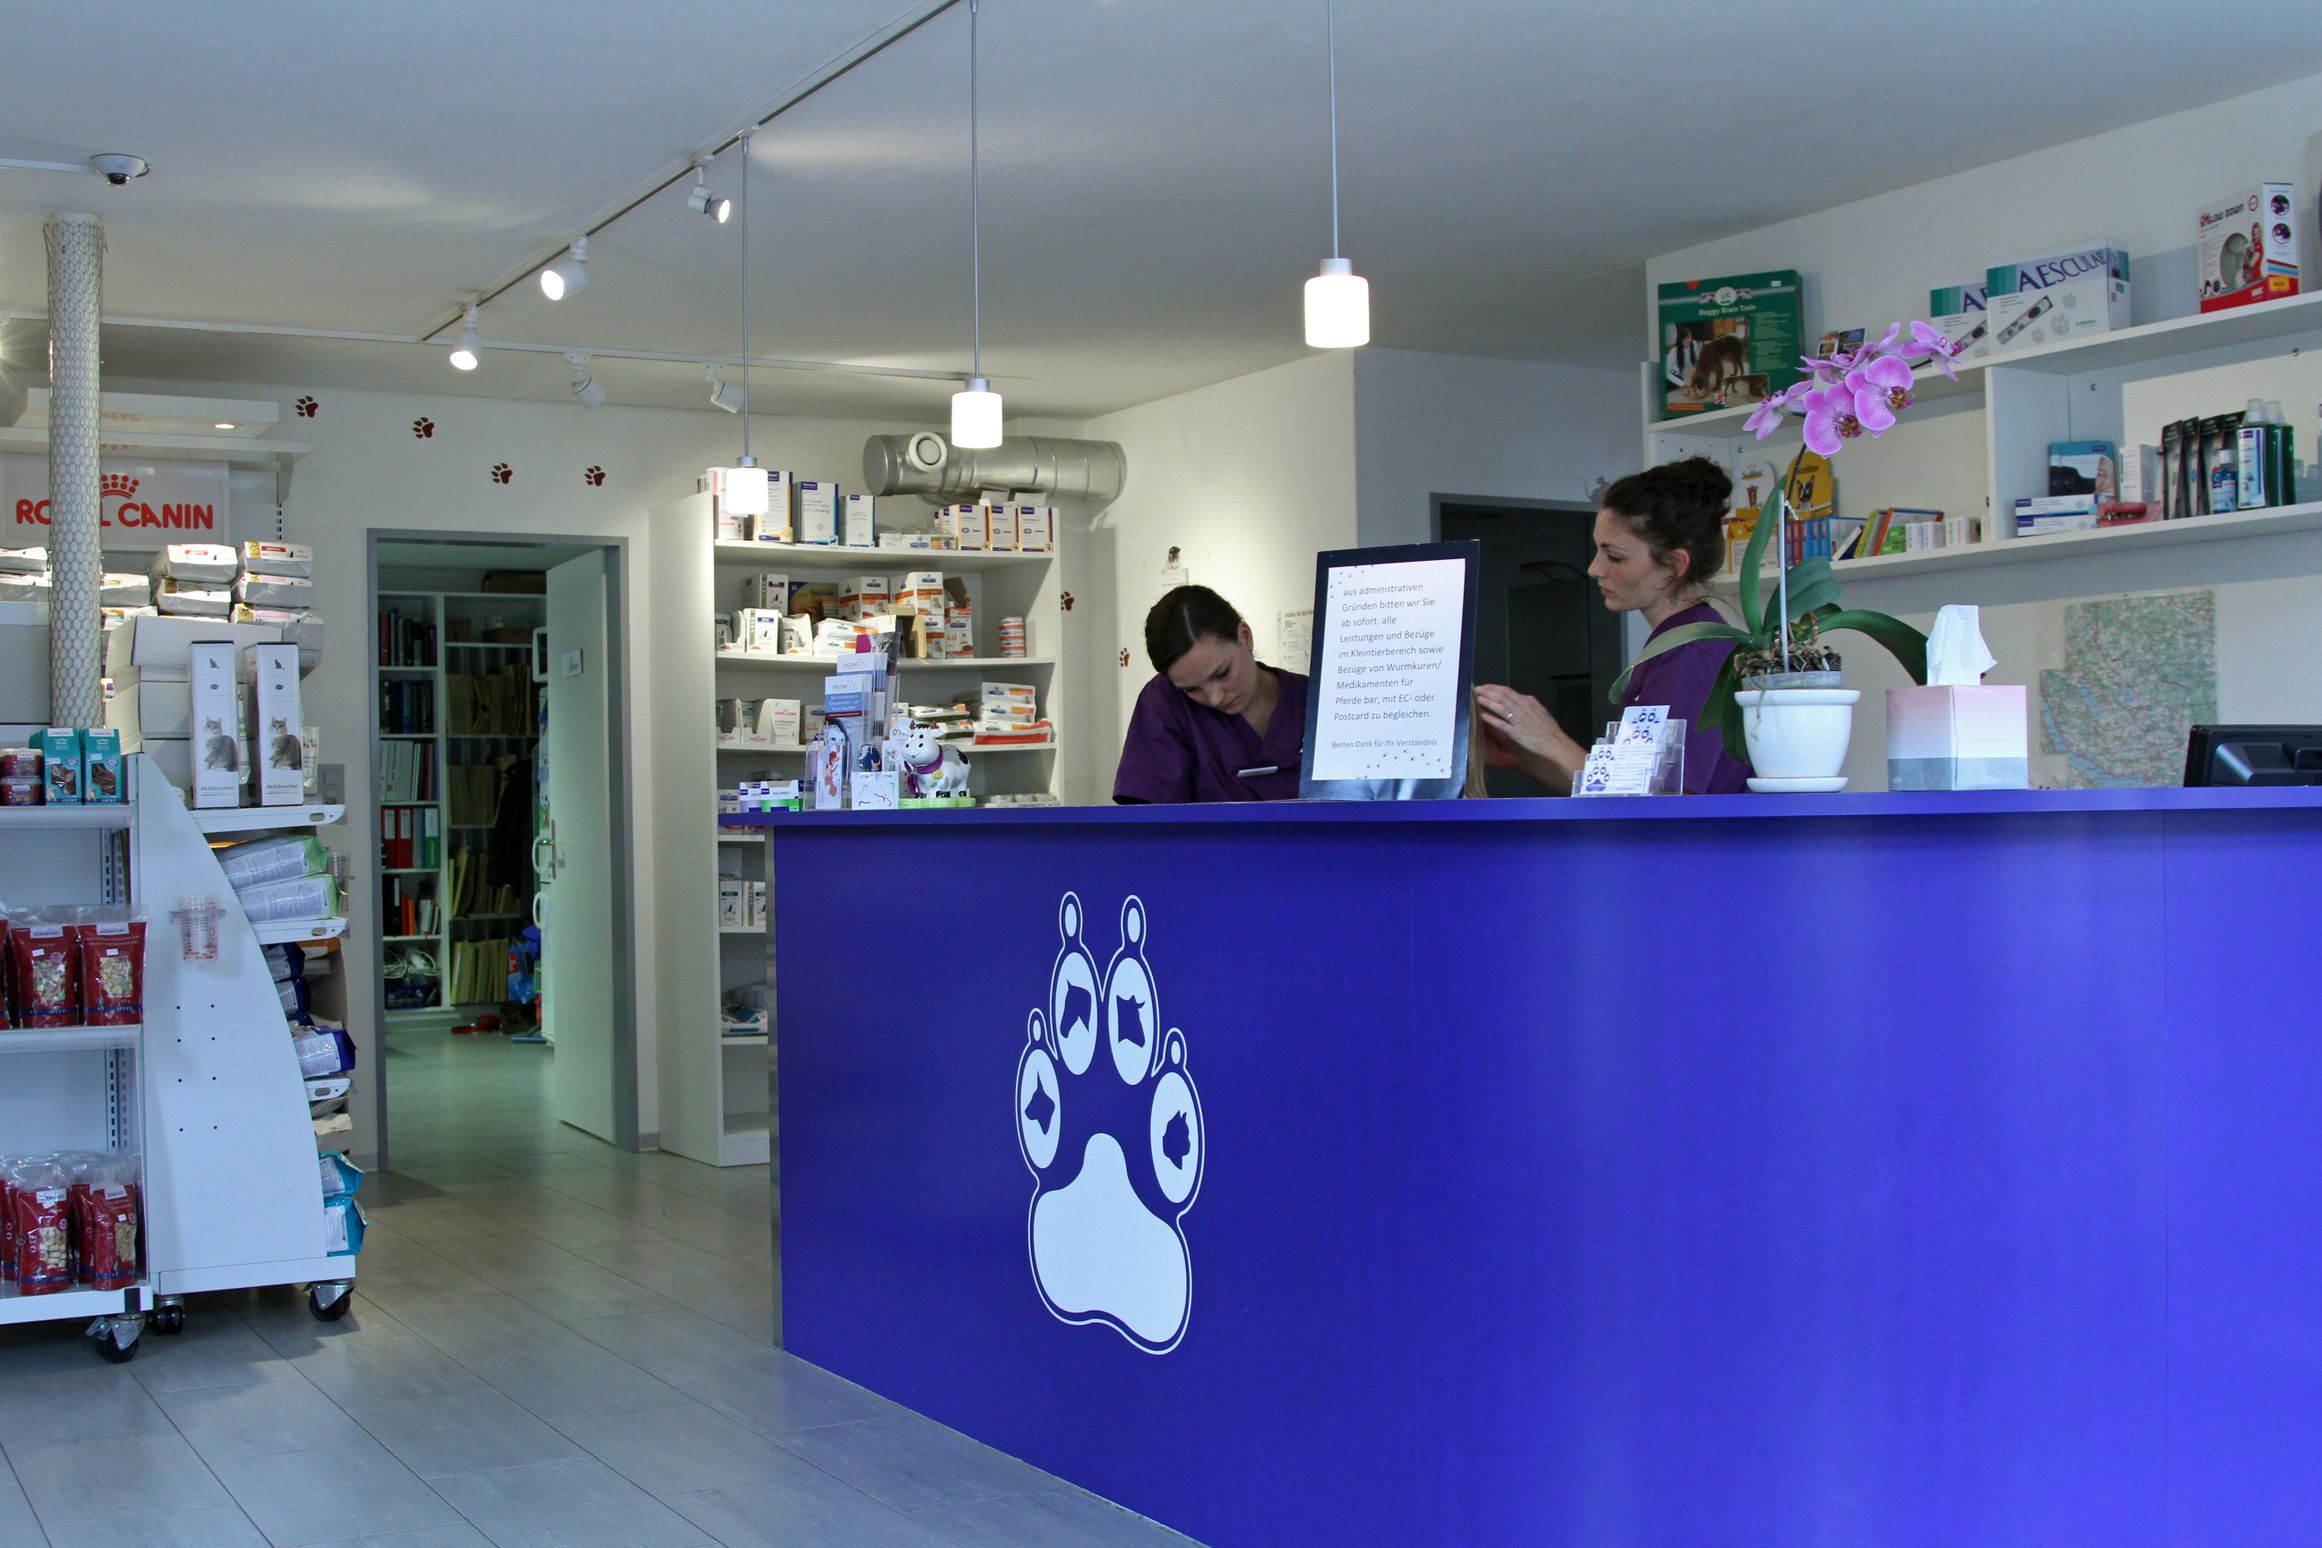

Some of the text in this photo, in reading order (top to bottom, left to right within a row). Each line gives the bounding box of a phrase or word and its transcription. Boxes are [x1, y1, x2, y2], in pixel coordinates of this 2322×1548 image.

[16, 498, 214, 530] ROL CANIN
[1343, 584, 1424, 597] aus administrativen
[1342, 597, 1435, 612] Gründen bitten wir Sie
[1341, 615, 1397, 627] ab sofort, alle
[1339, 630, 1435, 643] Leistungen und Bezüge
[1338, 645, 1444, 659] im Kleintierbereich sowie
[1337, 660, 1442, 675] Bezüge von Wurmkuren/
[1336, 678, 1413, 690] Medikamenten für
[1335, 696, 1362, 705] Pferde
[1382, 695, 1397, 703] mit
[1398, 693, 1413, 703] EC-
[1414, 693, 1435, 702] oder
[1334, 709, 1432, 721] Postcard zu begleichen.
[1331, 741, 1354, 749] Besten
[1355, 740, 1373, 748] Dank
[1374, 739, 1384, 747] für
